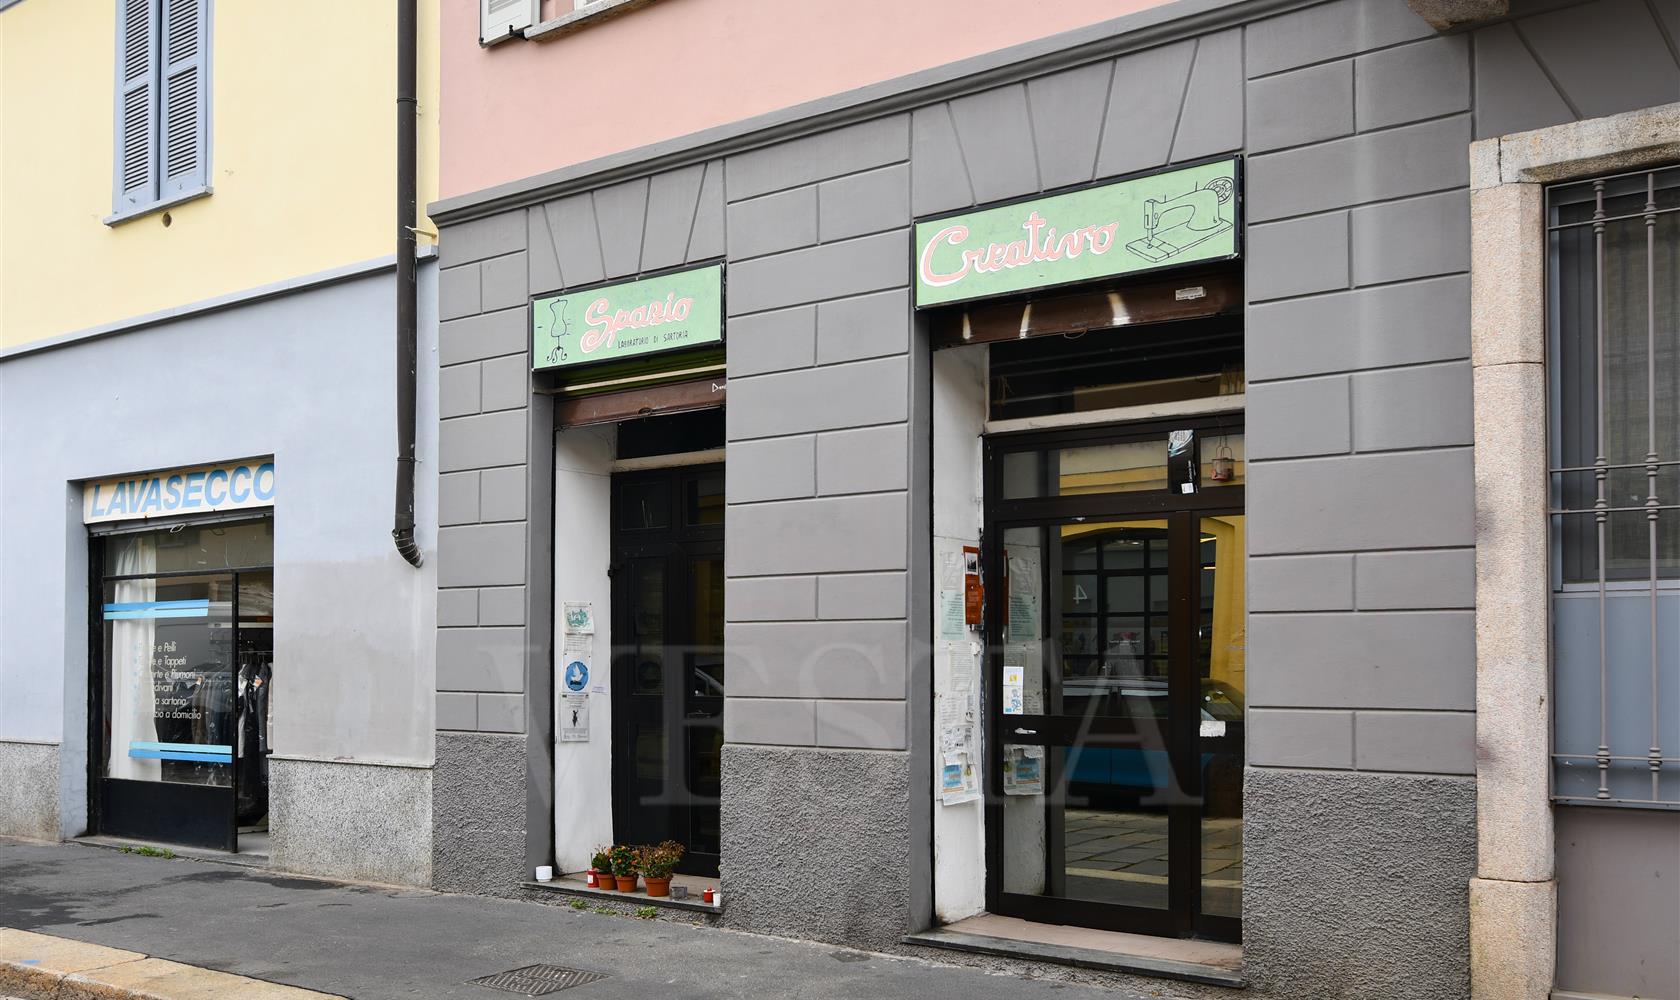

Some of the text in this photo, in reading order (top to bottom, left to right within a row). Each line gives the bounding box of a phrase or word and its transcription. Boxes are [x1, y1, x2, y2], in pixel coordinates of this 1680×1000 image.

[920, 211, 1120, 287] Creativo
[580, 292, 696, 353] Spazio
[653, 335, 659, 343] DI
[663, 330, 688, 343] SARTORIA
[91, 463, 274, 517] LAVASECCO
[164, 655, 187, 668] Tappeti
[161, 696, 187, 706] sartoria
[172, 708, 202, 719] domicilio
